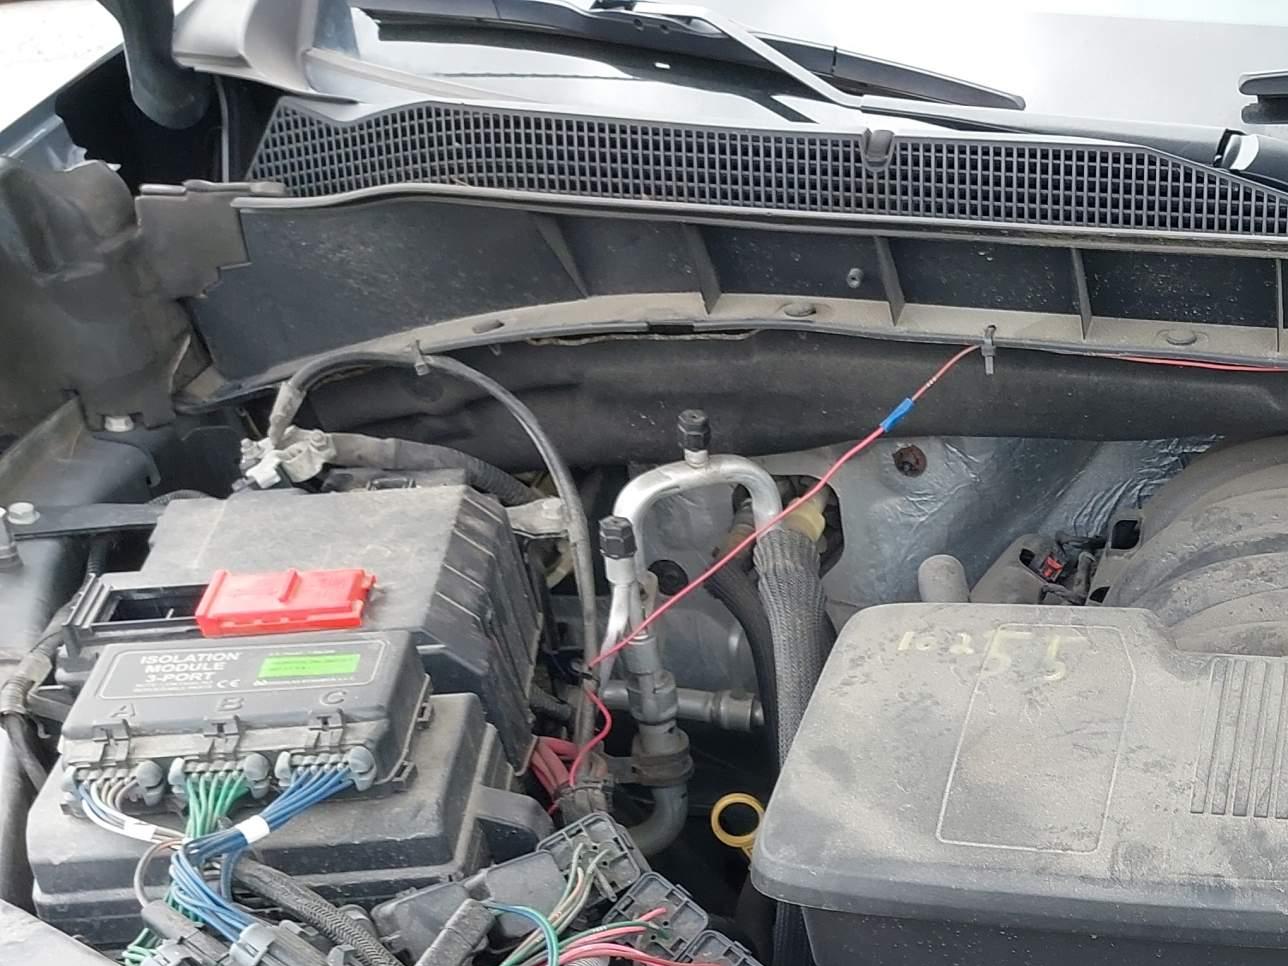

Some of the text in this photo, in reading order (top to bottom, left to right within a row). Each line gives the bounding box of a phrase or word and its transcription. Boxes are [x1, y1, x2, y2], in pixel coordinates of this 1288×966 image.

[140, 652, 240, 664] ISOLATION
[145, 662, 226, 673] MODULE
[145, 672, 216, 683] 3-PORT
[319, 690, 347, 705] C
[217, 697, 245, 712] B
